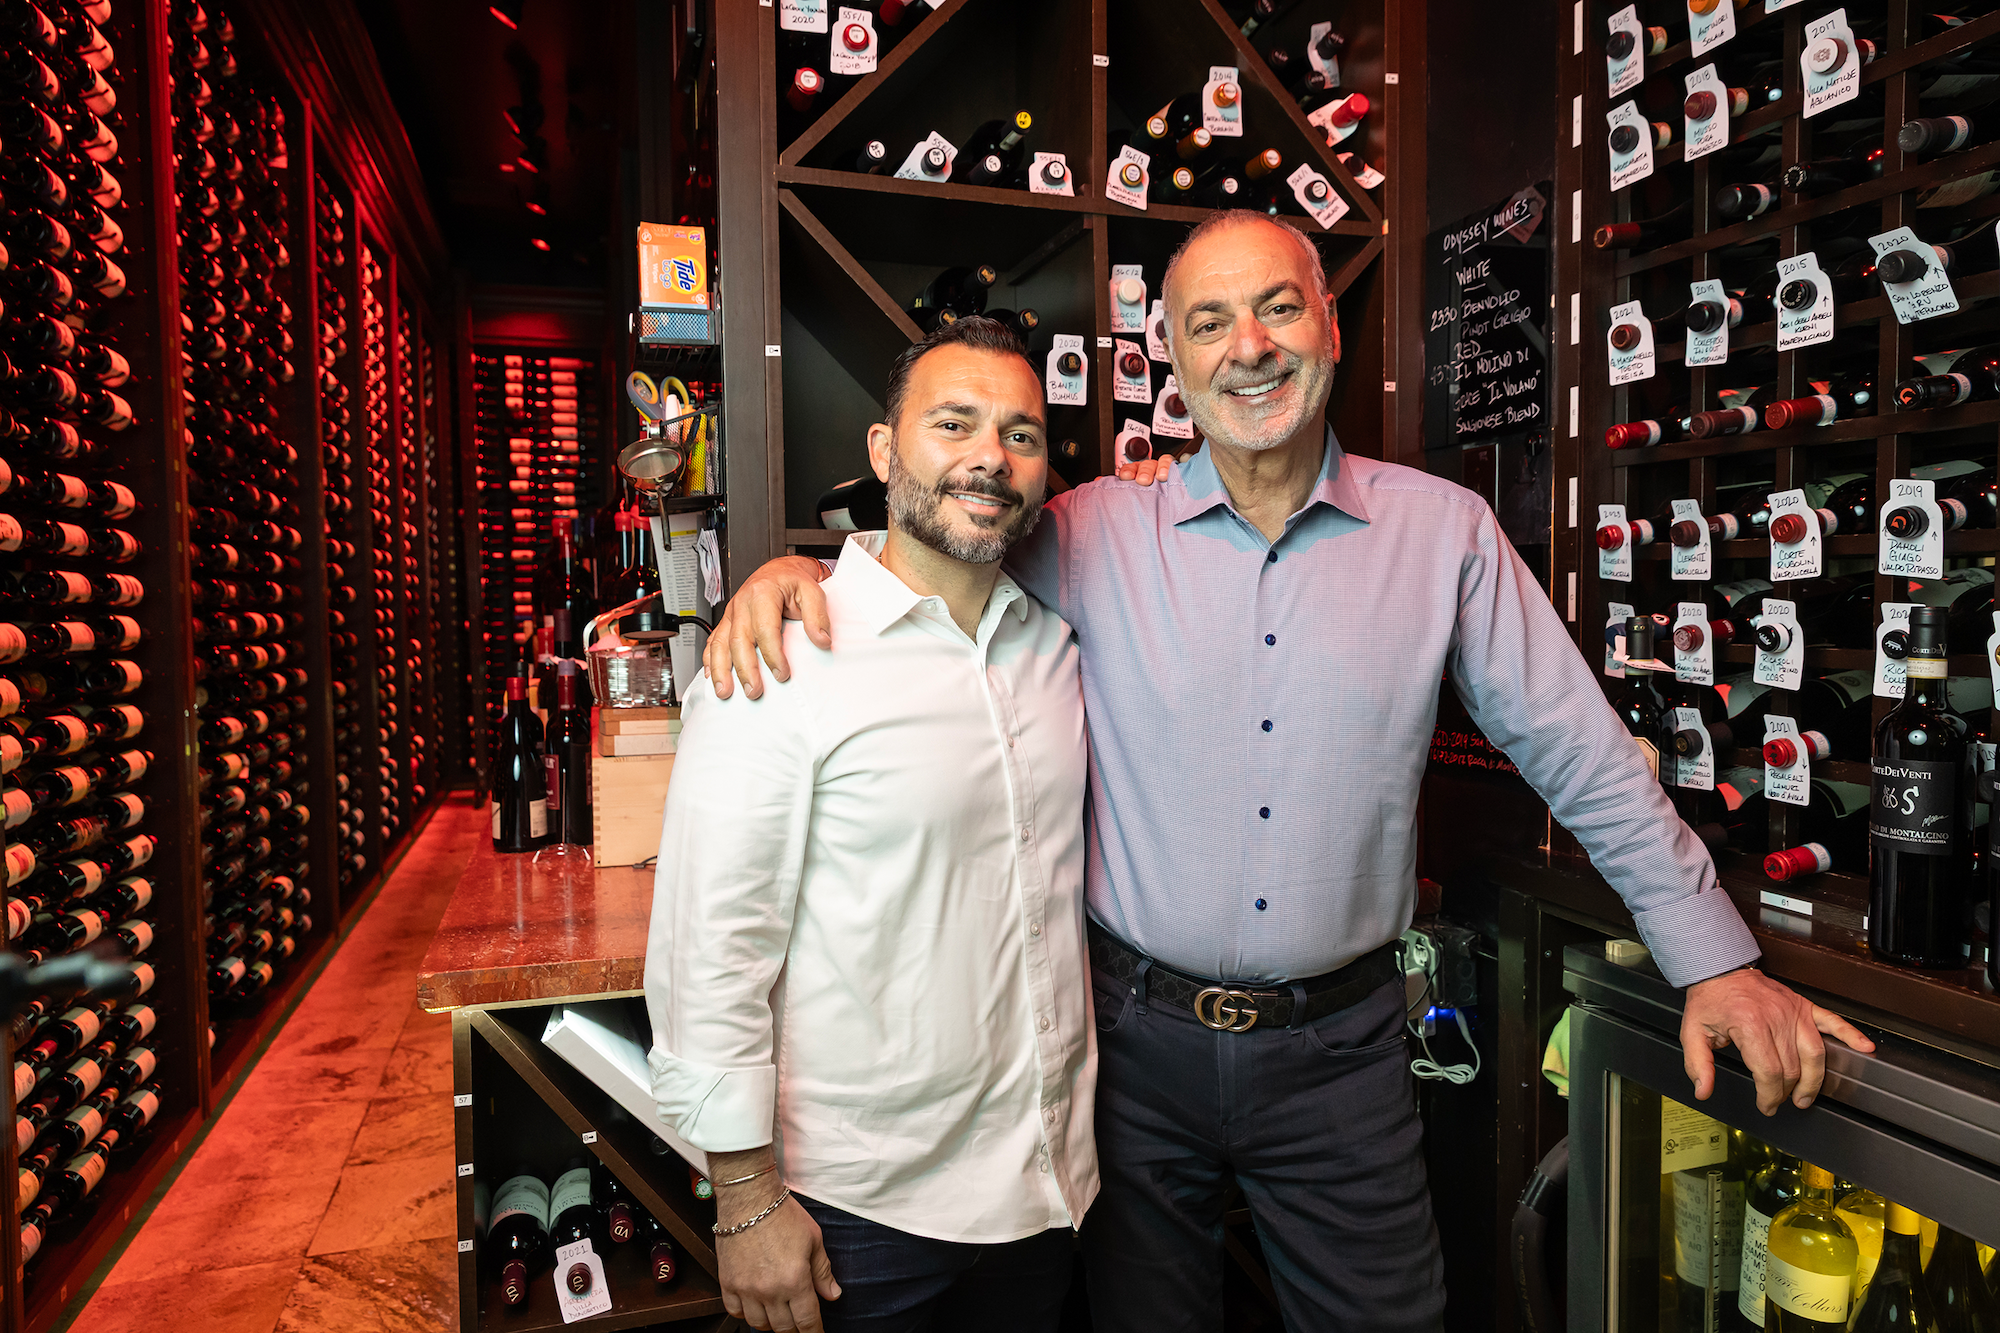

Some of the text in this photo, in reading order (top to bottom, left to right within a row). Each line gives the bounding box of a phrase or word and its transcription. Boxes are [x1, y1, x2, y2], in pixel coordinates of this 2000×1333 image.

[792, 16, 815, 24] 2020
[1612, 11, 1630, 30] 2015
[1812, 20, 1836, 39] 2017
[1213, 71, 1233, 82] 2014
[1689, 69, 1711, 89] 2018
[1612, 106, 1632, 125] 2015
[1443, 199, 1529, 254] ODYSSEY WINES
[1878, 236, 1909, 251] 2020
[1456, 259, 1491, 286] WHITE
[1782, 258, 1808, 276] 2015
[660, 274, 672, 289] go
[671, 258, 696, 292] Tide
[1695, 284, 1715, 296] 2019
[1430, 290, 1520, 332] 2330 BENVOLIO
[1614, 306, 1634, 320] 2021
[1460, 306, 1531, 339] PINOT GRIGIO
[1058, 339, 1080, 349] 2020
[1454, 340, 1481, 361] RED
[1454, 362, 1472, 382] IL
[1476, 351, 1512, 375] MOLINO
[1516, 348, 1530, 364] DI
[1049, 380, 1078, 390] BANFI
[1505, 402, 1541, 424] BLEND
[1896, 484, 1924, 498] 2019
[1676, 502, 1692, 515] 2019
[1774, 496, 1799, 509] 2020
[1888, 538, 1925, 552] DAMOLI
[1779, 550, 1806, 560] CORTE
[1888, 550, 1922, 563] GIAGO
[1882, 562, 1939, 575] VALPO RIPASSO
[1682, 607, 1702, 617] 2020
[1768, 604, 1790, 615] 2020
[1890, 608, 1909, 620] 202
[1680, 712, 1697, 723] 2019
[1770, 722, 1791, 734] 2021
[1772, 782, 1800, 792] LAMURI
[1901, 786, 1920, 816] S
[1890, 827, 1949, 840] MONTALCINO
[1782, 898, 1789, 907] 61
[614, 1225, 630, 1239] VD
[562, 1245, 588, 1261] 2021
[658, 1264, 671, 1280] VD
[572, 1276, 585, 1292] VD
[505, 1285, 520, 1302] VD
[1790, 1288, 1842, 1314] Cellars
